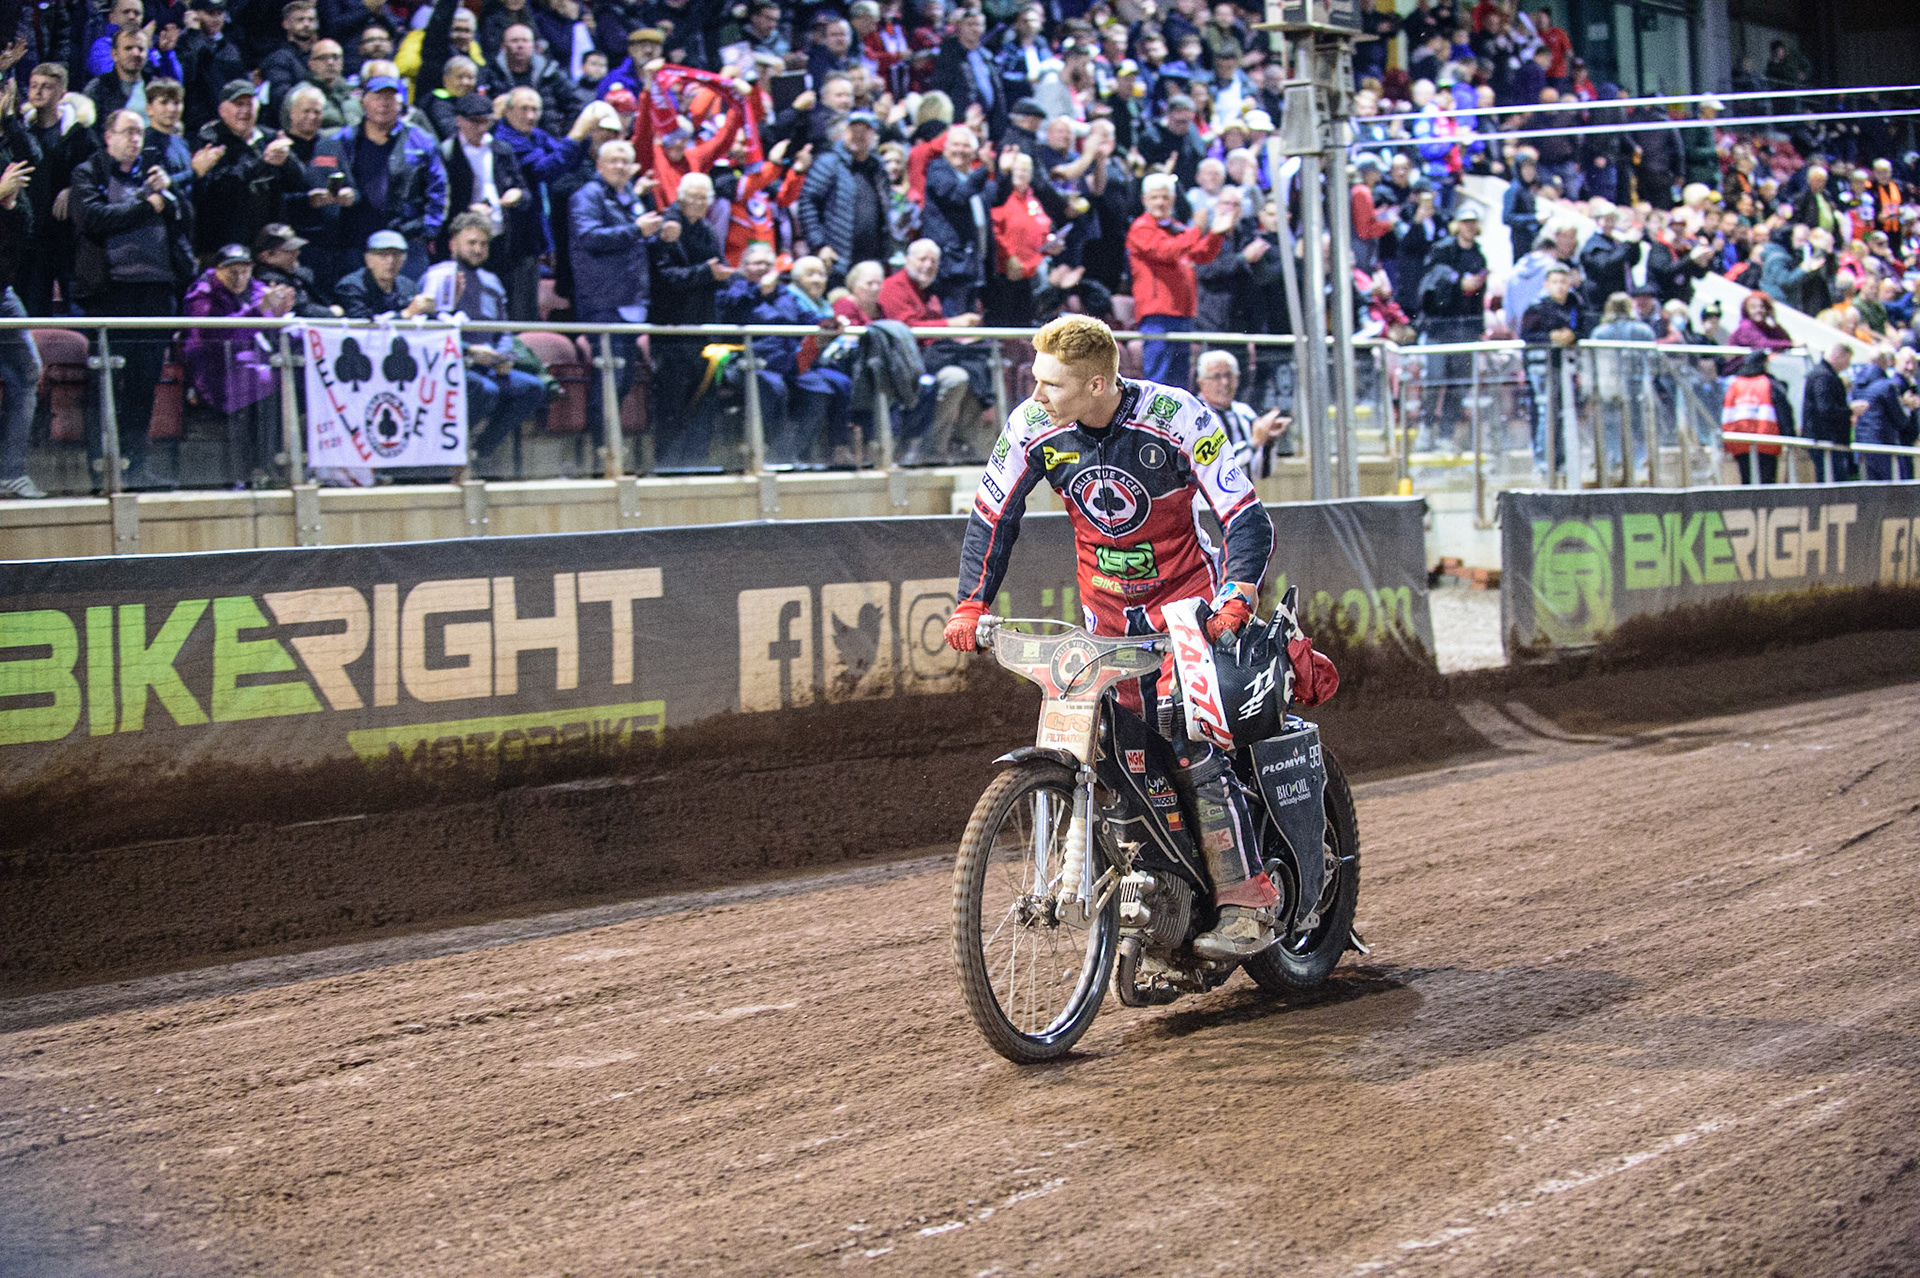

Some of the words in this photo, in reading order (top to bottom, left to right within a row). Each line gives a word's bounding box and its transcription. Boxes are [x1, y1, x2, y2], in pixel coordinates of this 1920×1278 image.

[308, 329, 373, 461] BELLE
[412, 347, 439, 437] VUE
[441, 335, 461, 450] ACES
[1073, 472, 1093, 495] BELLE
[1095, 470, 1116, 479] VUE
[1119, 476, 1142, 496] ACES
[1622, 504, 1857, 591] BIKERIGHT
[1091, 575, 1168, 595] BIKERIGHT
[0, 567, 663, 746] BIKERIGHT
[1127, 752, 1144, 766] NGK
